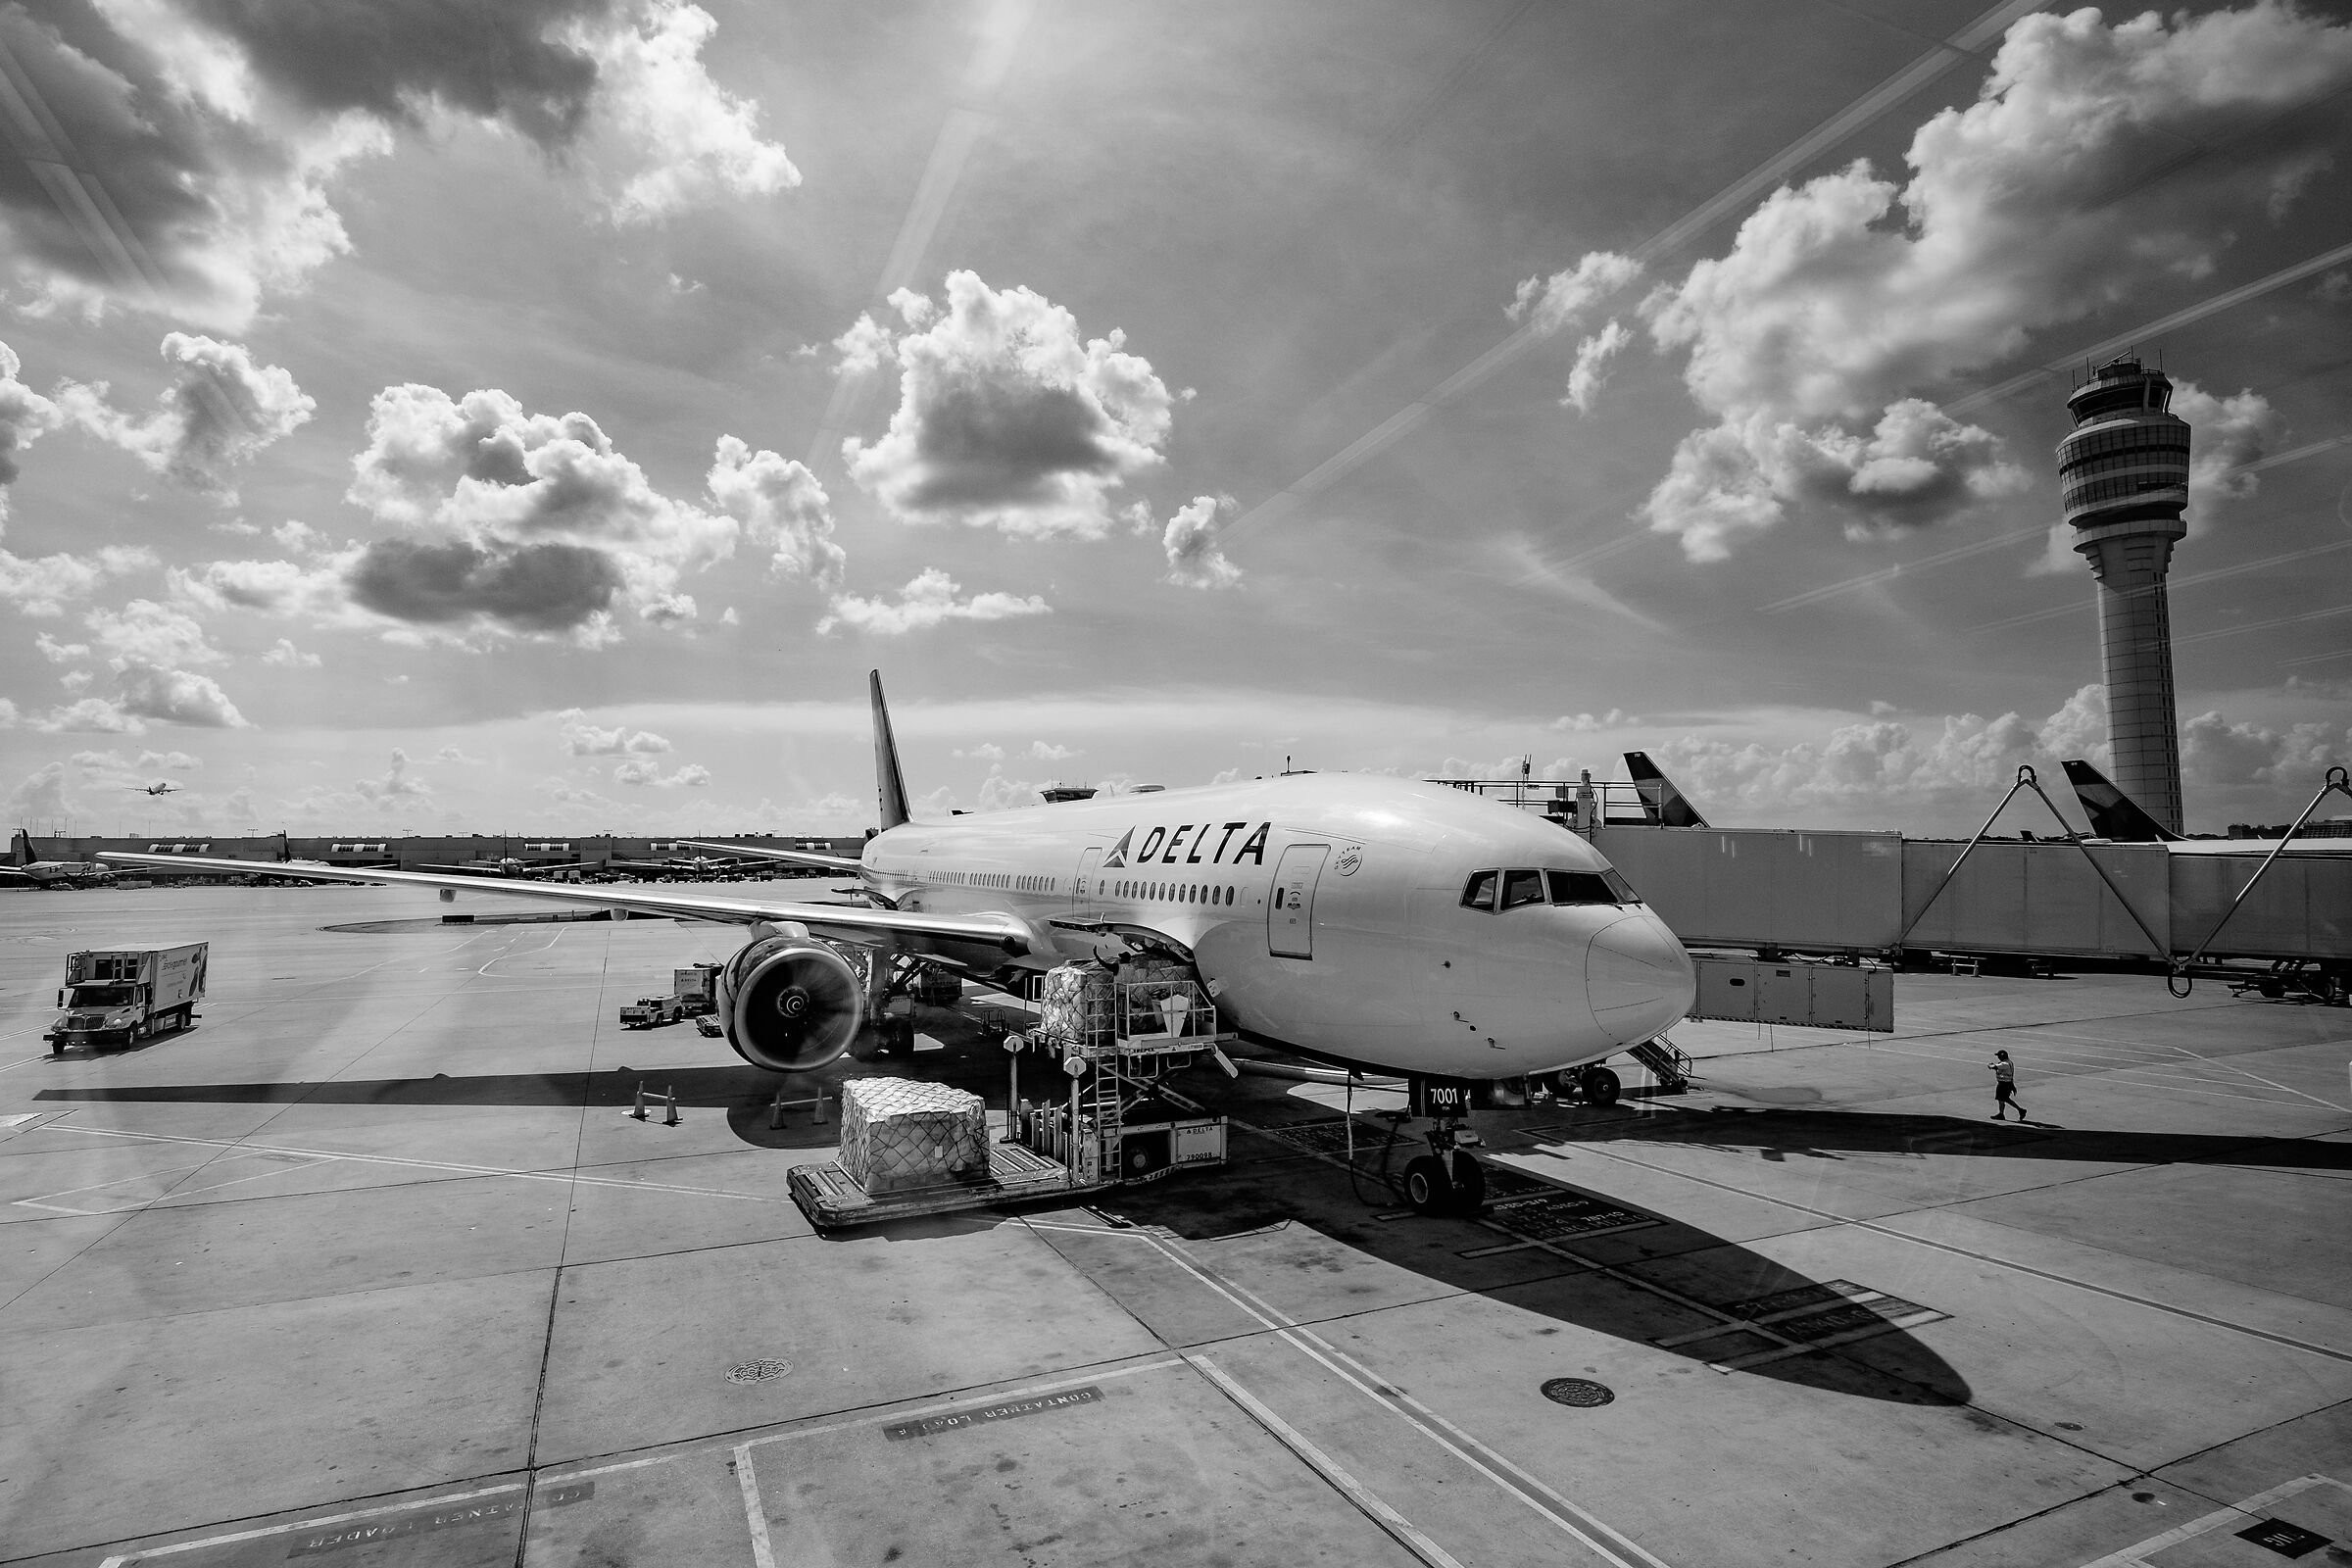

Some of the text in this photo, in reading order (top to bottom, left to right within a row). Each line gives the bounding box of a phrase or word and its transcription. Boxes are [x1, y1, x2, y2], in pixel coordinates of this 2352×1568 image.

[1136, 821, 1272, 865] DELTA
[1430, 1088, 1458, 1104] 7001
[984, 1392, 1093, 1419] CONTAINER
